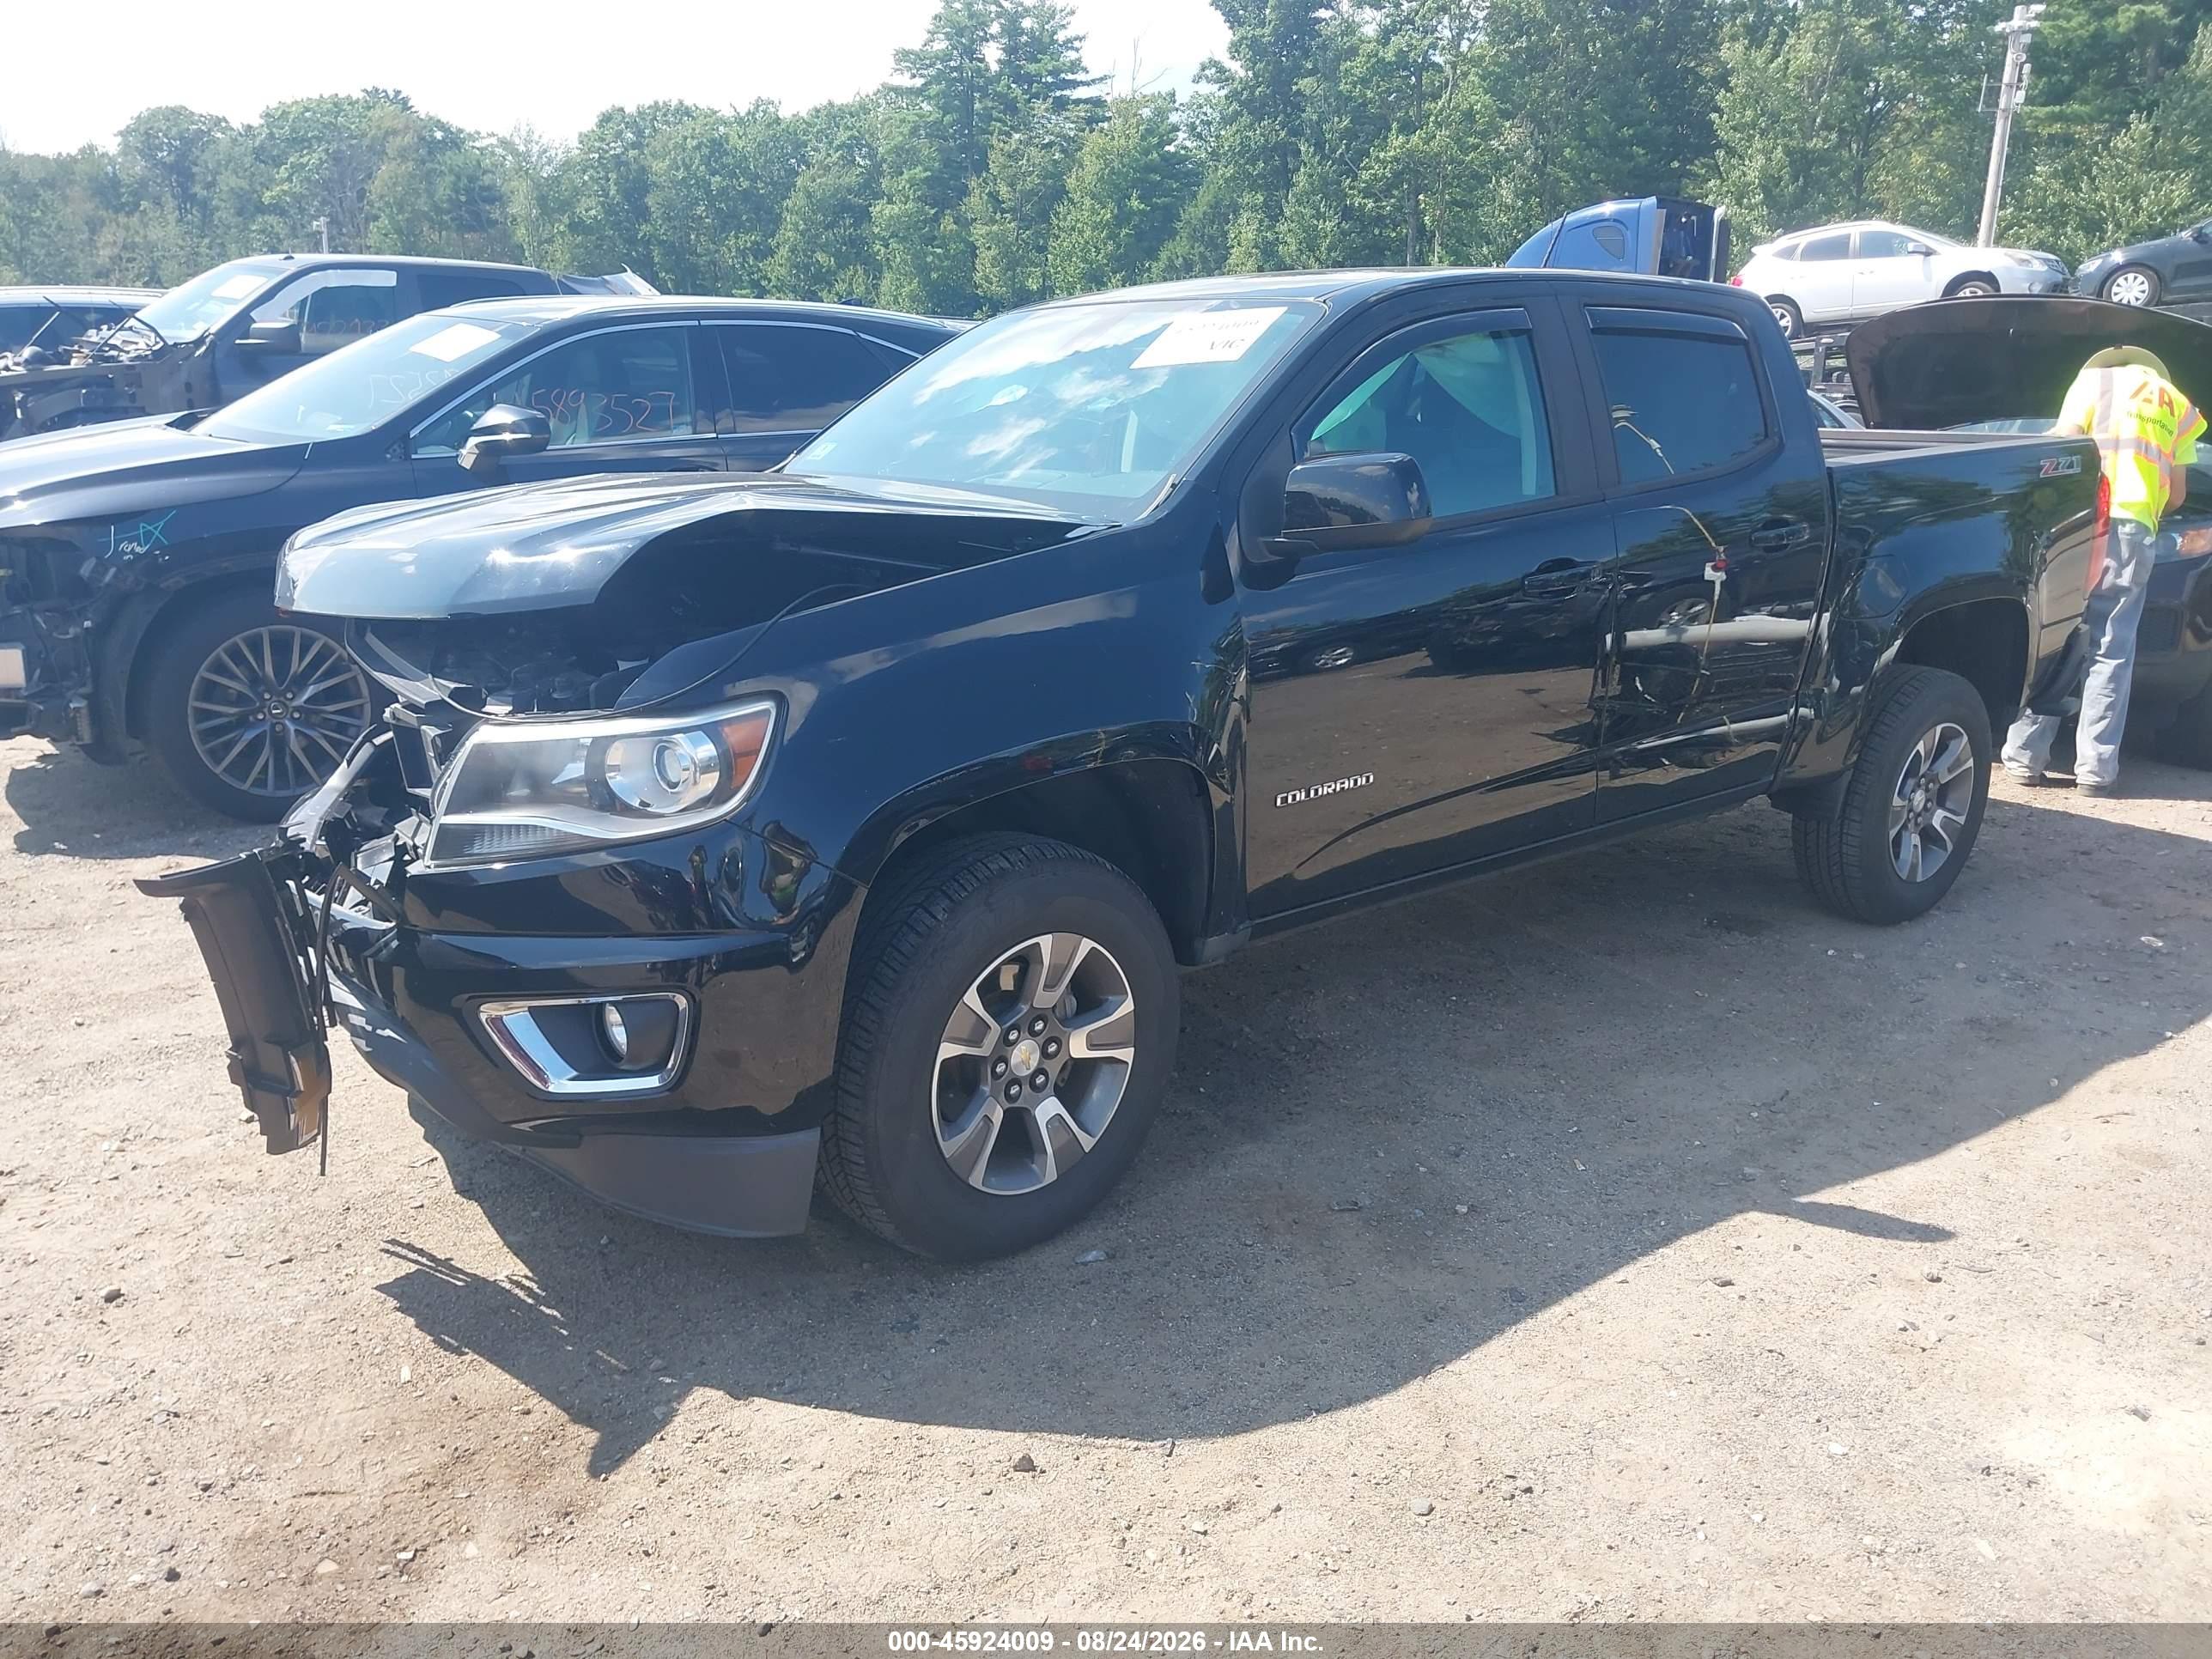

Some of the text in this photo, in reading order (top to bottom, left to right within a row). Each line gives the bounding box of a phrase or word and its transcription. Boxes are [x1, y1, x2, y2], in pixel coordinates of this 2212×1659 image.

[531, 388, 677, 435] 5893527
[2039, 455, 2082, 478] Z71
[1276, 772, 1374, 808] COLORADO
